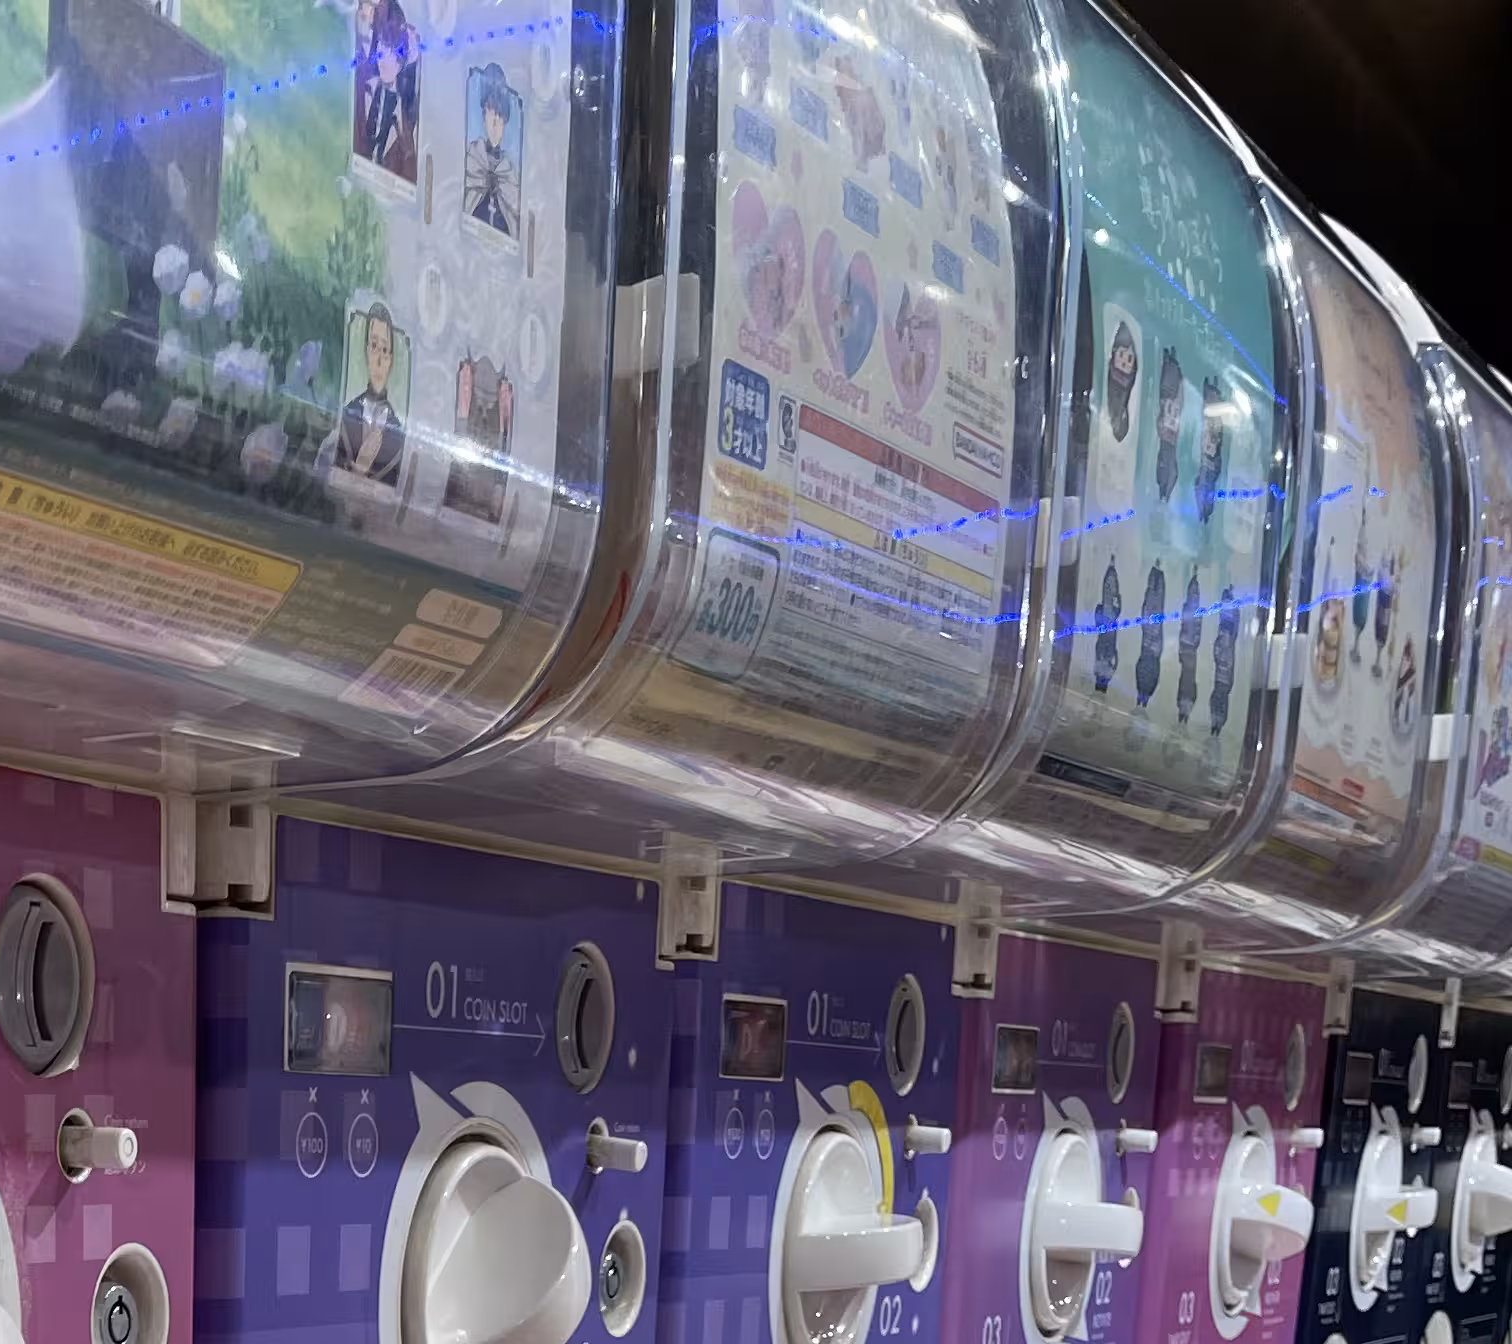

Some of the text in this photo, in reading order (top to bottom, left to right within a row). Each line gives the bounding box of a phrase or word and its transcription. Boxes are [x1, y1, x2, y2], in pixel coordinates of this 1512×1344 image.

[426, 961, 458, 1019] 01
[463, 997, 528, 1025] COIN SLOT
[807, 990, 828, 1036] 01
[1096, 1271, 1112, 1305] 02
[880, 1295, 902, 1336] 02
